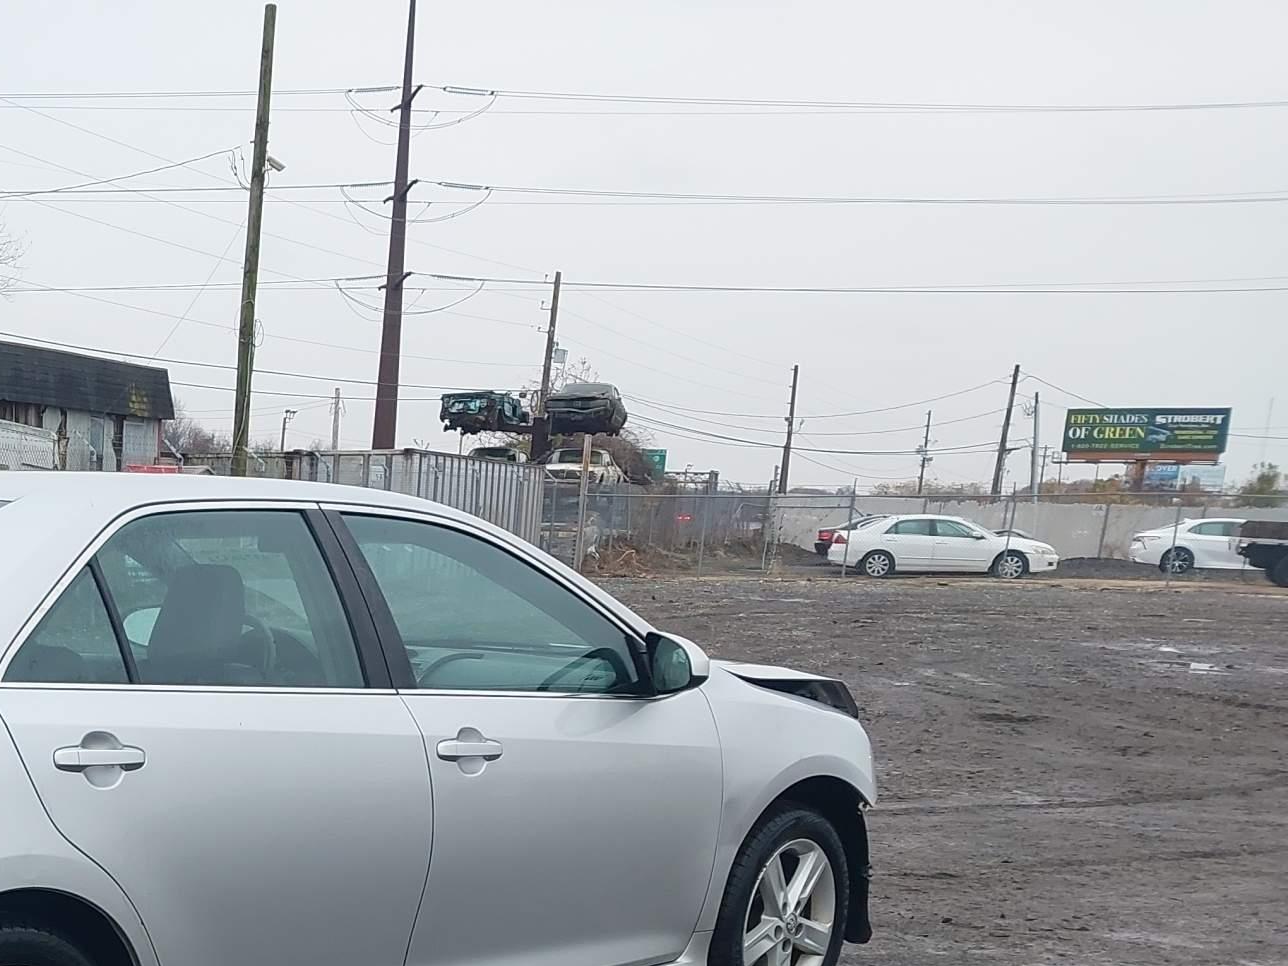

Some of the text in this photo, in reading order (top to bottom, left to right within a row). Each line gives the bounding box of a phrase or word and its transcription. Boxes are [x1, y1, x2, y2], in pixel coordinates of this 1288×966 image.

[1071, 414, 1149, 424] FIFTY SHADES
[1155, 414, 1226, 425] STROBERT
[1068, 426, 1145, 440] OF GREEN
